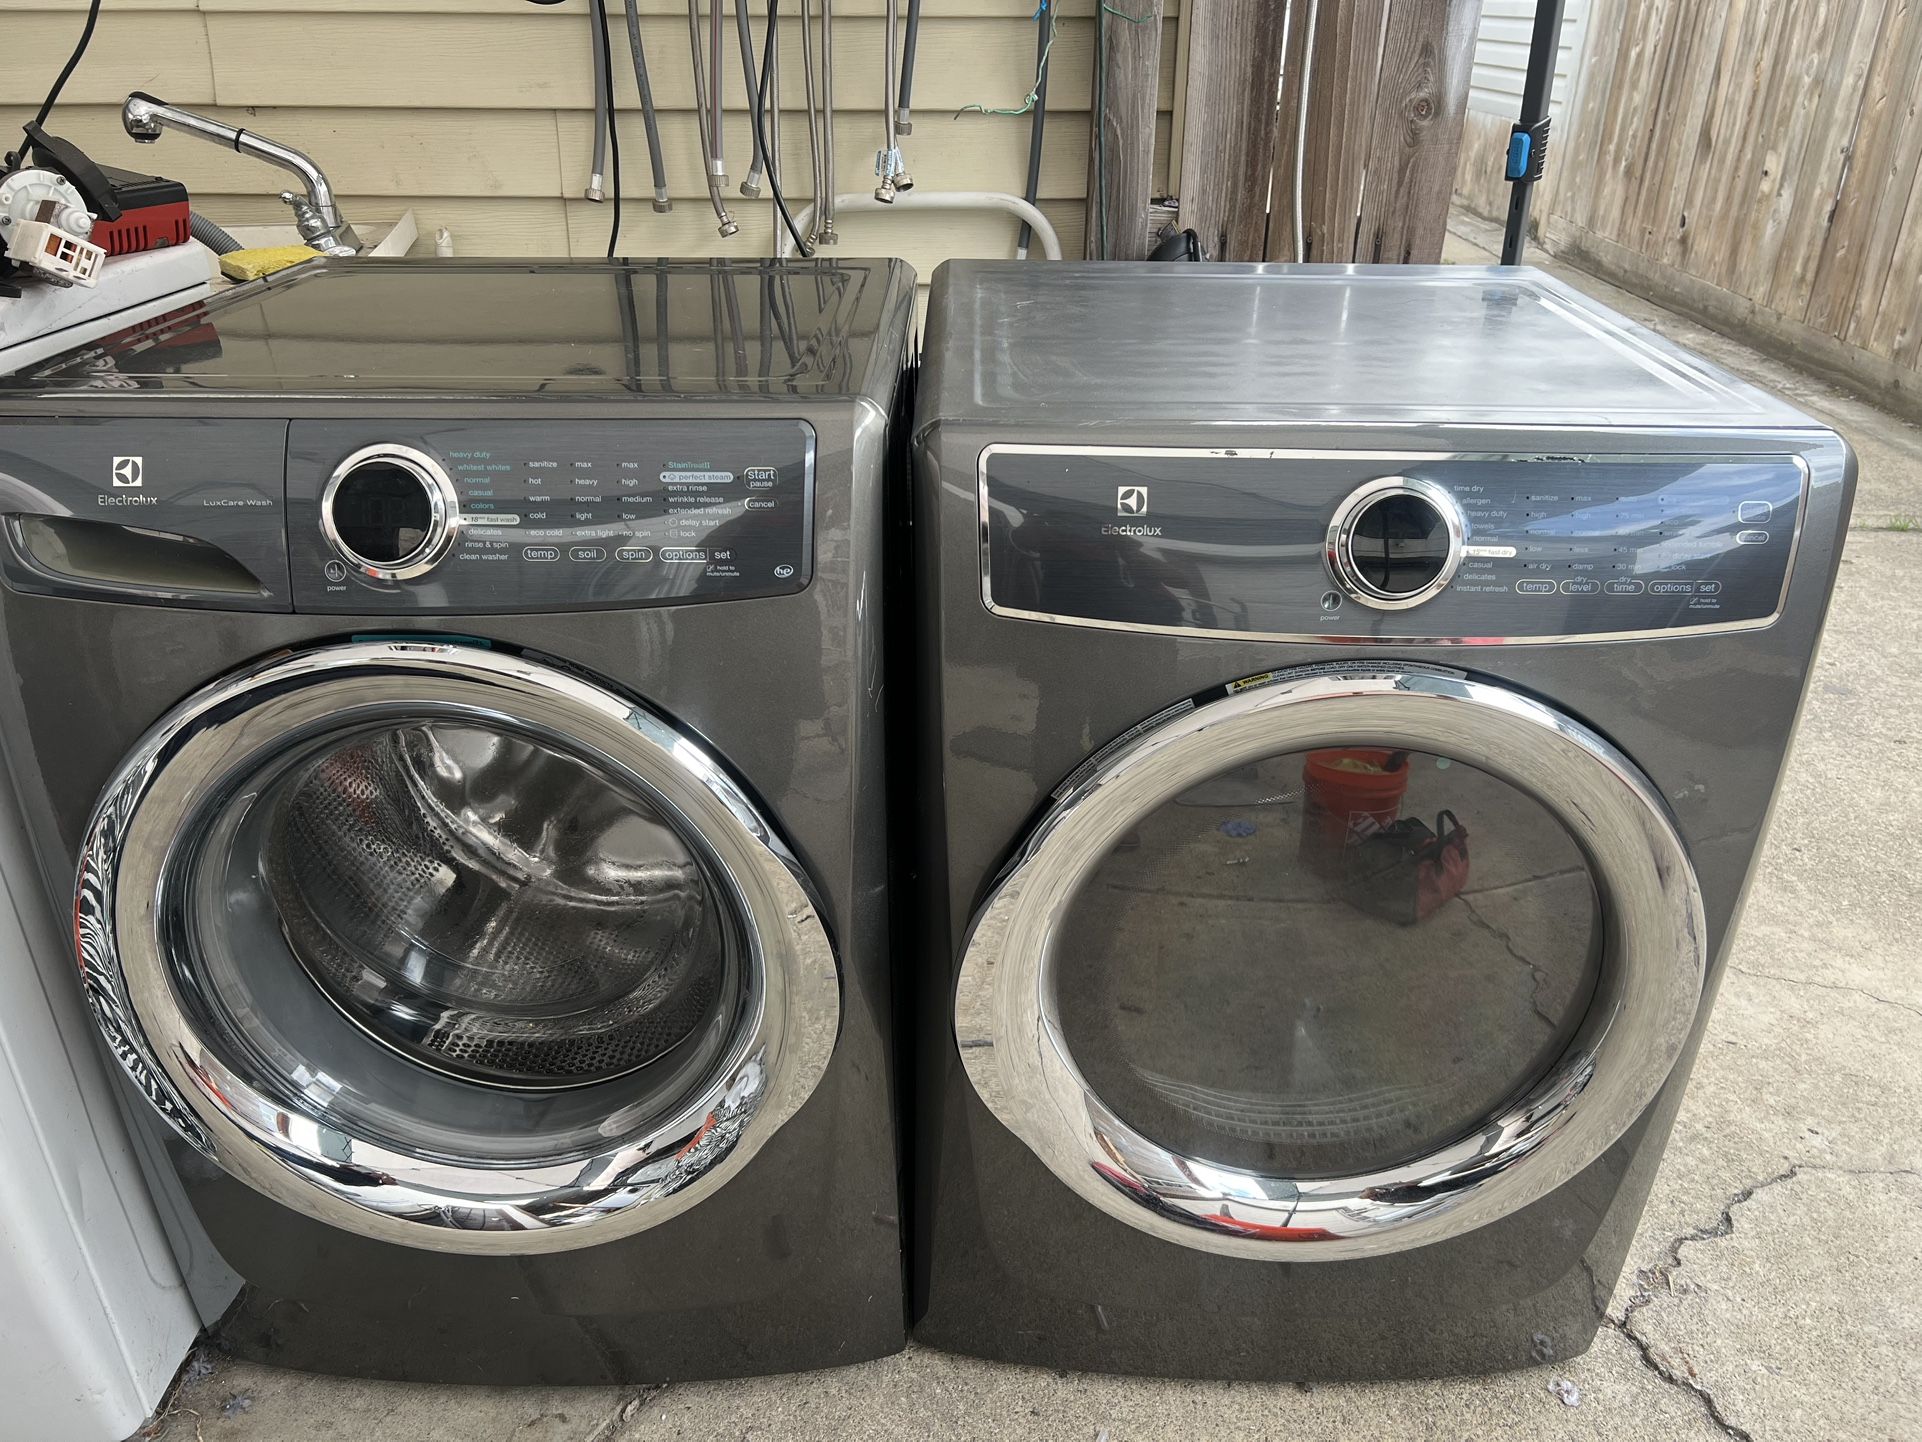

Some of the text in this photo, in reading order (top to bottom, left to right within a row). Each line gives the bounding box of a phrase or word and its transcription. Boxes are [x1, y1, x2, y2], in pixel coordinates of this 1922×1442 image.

[450, 451, 491, 459] heavy duty
[678, 474, 706, 482] perfect
[747, 469, 775, 480] start
[575, 478, 598, 487] heavy
[98, 495, 157, 506] Electrolux
[576, 512, 592, 521] light
[1531, 512, 1546, 520] high
[680, 519, 700, 527] delay
[597, 530, 613, 538] light
[635, 530, 650, 538] spin
[1101, 524, 1162, 536] Electrolux
[492, 541, 509, 549] spin
[528, 549, 555, 559] temp
[578, 550, 596, 558] soil
[623, 551, 645, 561] spin
[666, 551, 705, 561] options
[714, 551, 730, 559] set
[1523, 583, 1549, 592] temp
[1614, 583, 1635, 592] time
[1654, 583, 1691, 593] options
[1700, 583, 1715, 592] set
[1320, 614, 1340, 622] power
[1243, 673, 1269, 684] WARNING
